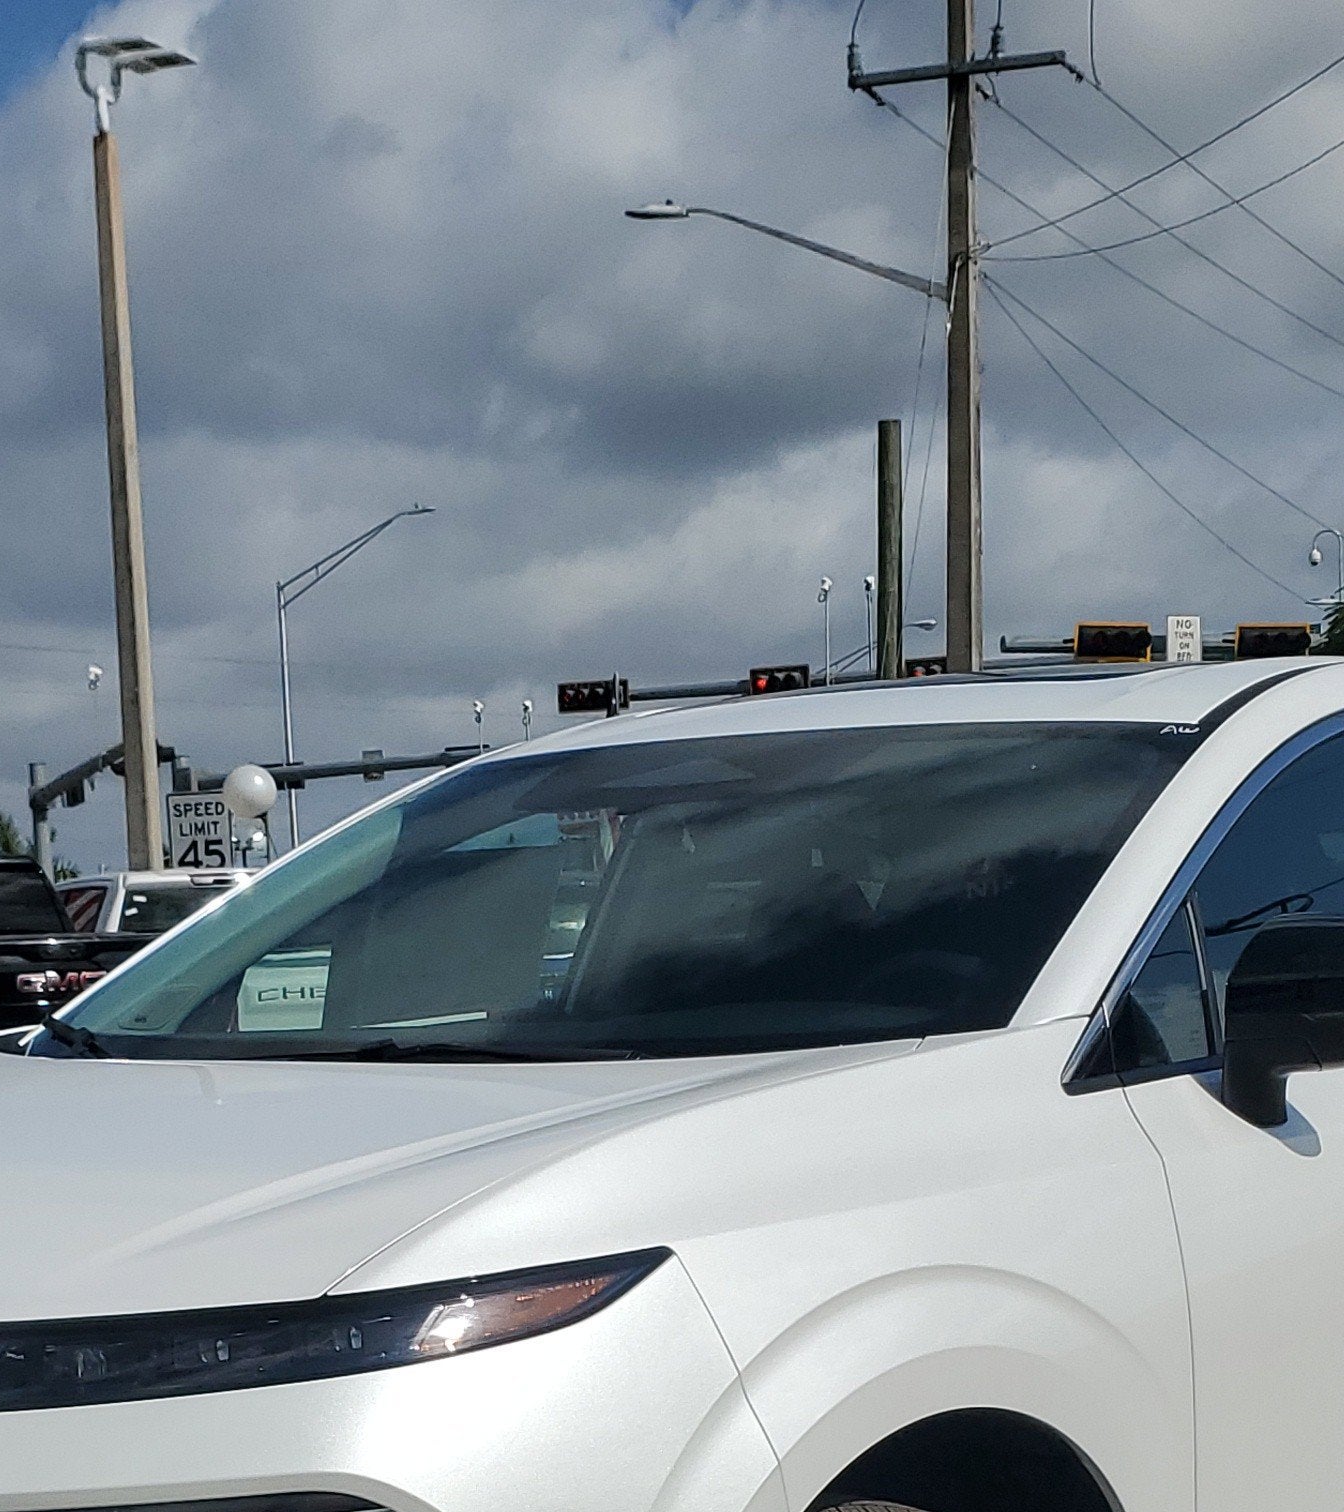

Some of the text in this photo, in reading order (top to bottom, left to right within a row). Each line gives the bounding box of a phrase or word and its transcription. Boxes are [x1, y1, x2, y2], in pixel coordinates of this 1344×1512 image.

[1176, 619, 1192, 630] NO
[1174, 631, 1194, 640] TURN
[1179, 641, 1190, 650] ON
[173, 802, 225, 818] SPEED
[179, 821, 220, 837] LIMIT
[178, 839, 226, 868] 45
[17, 971, 107, 993] GMC
